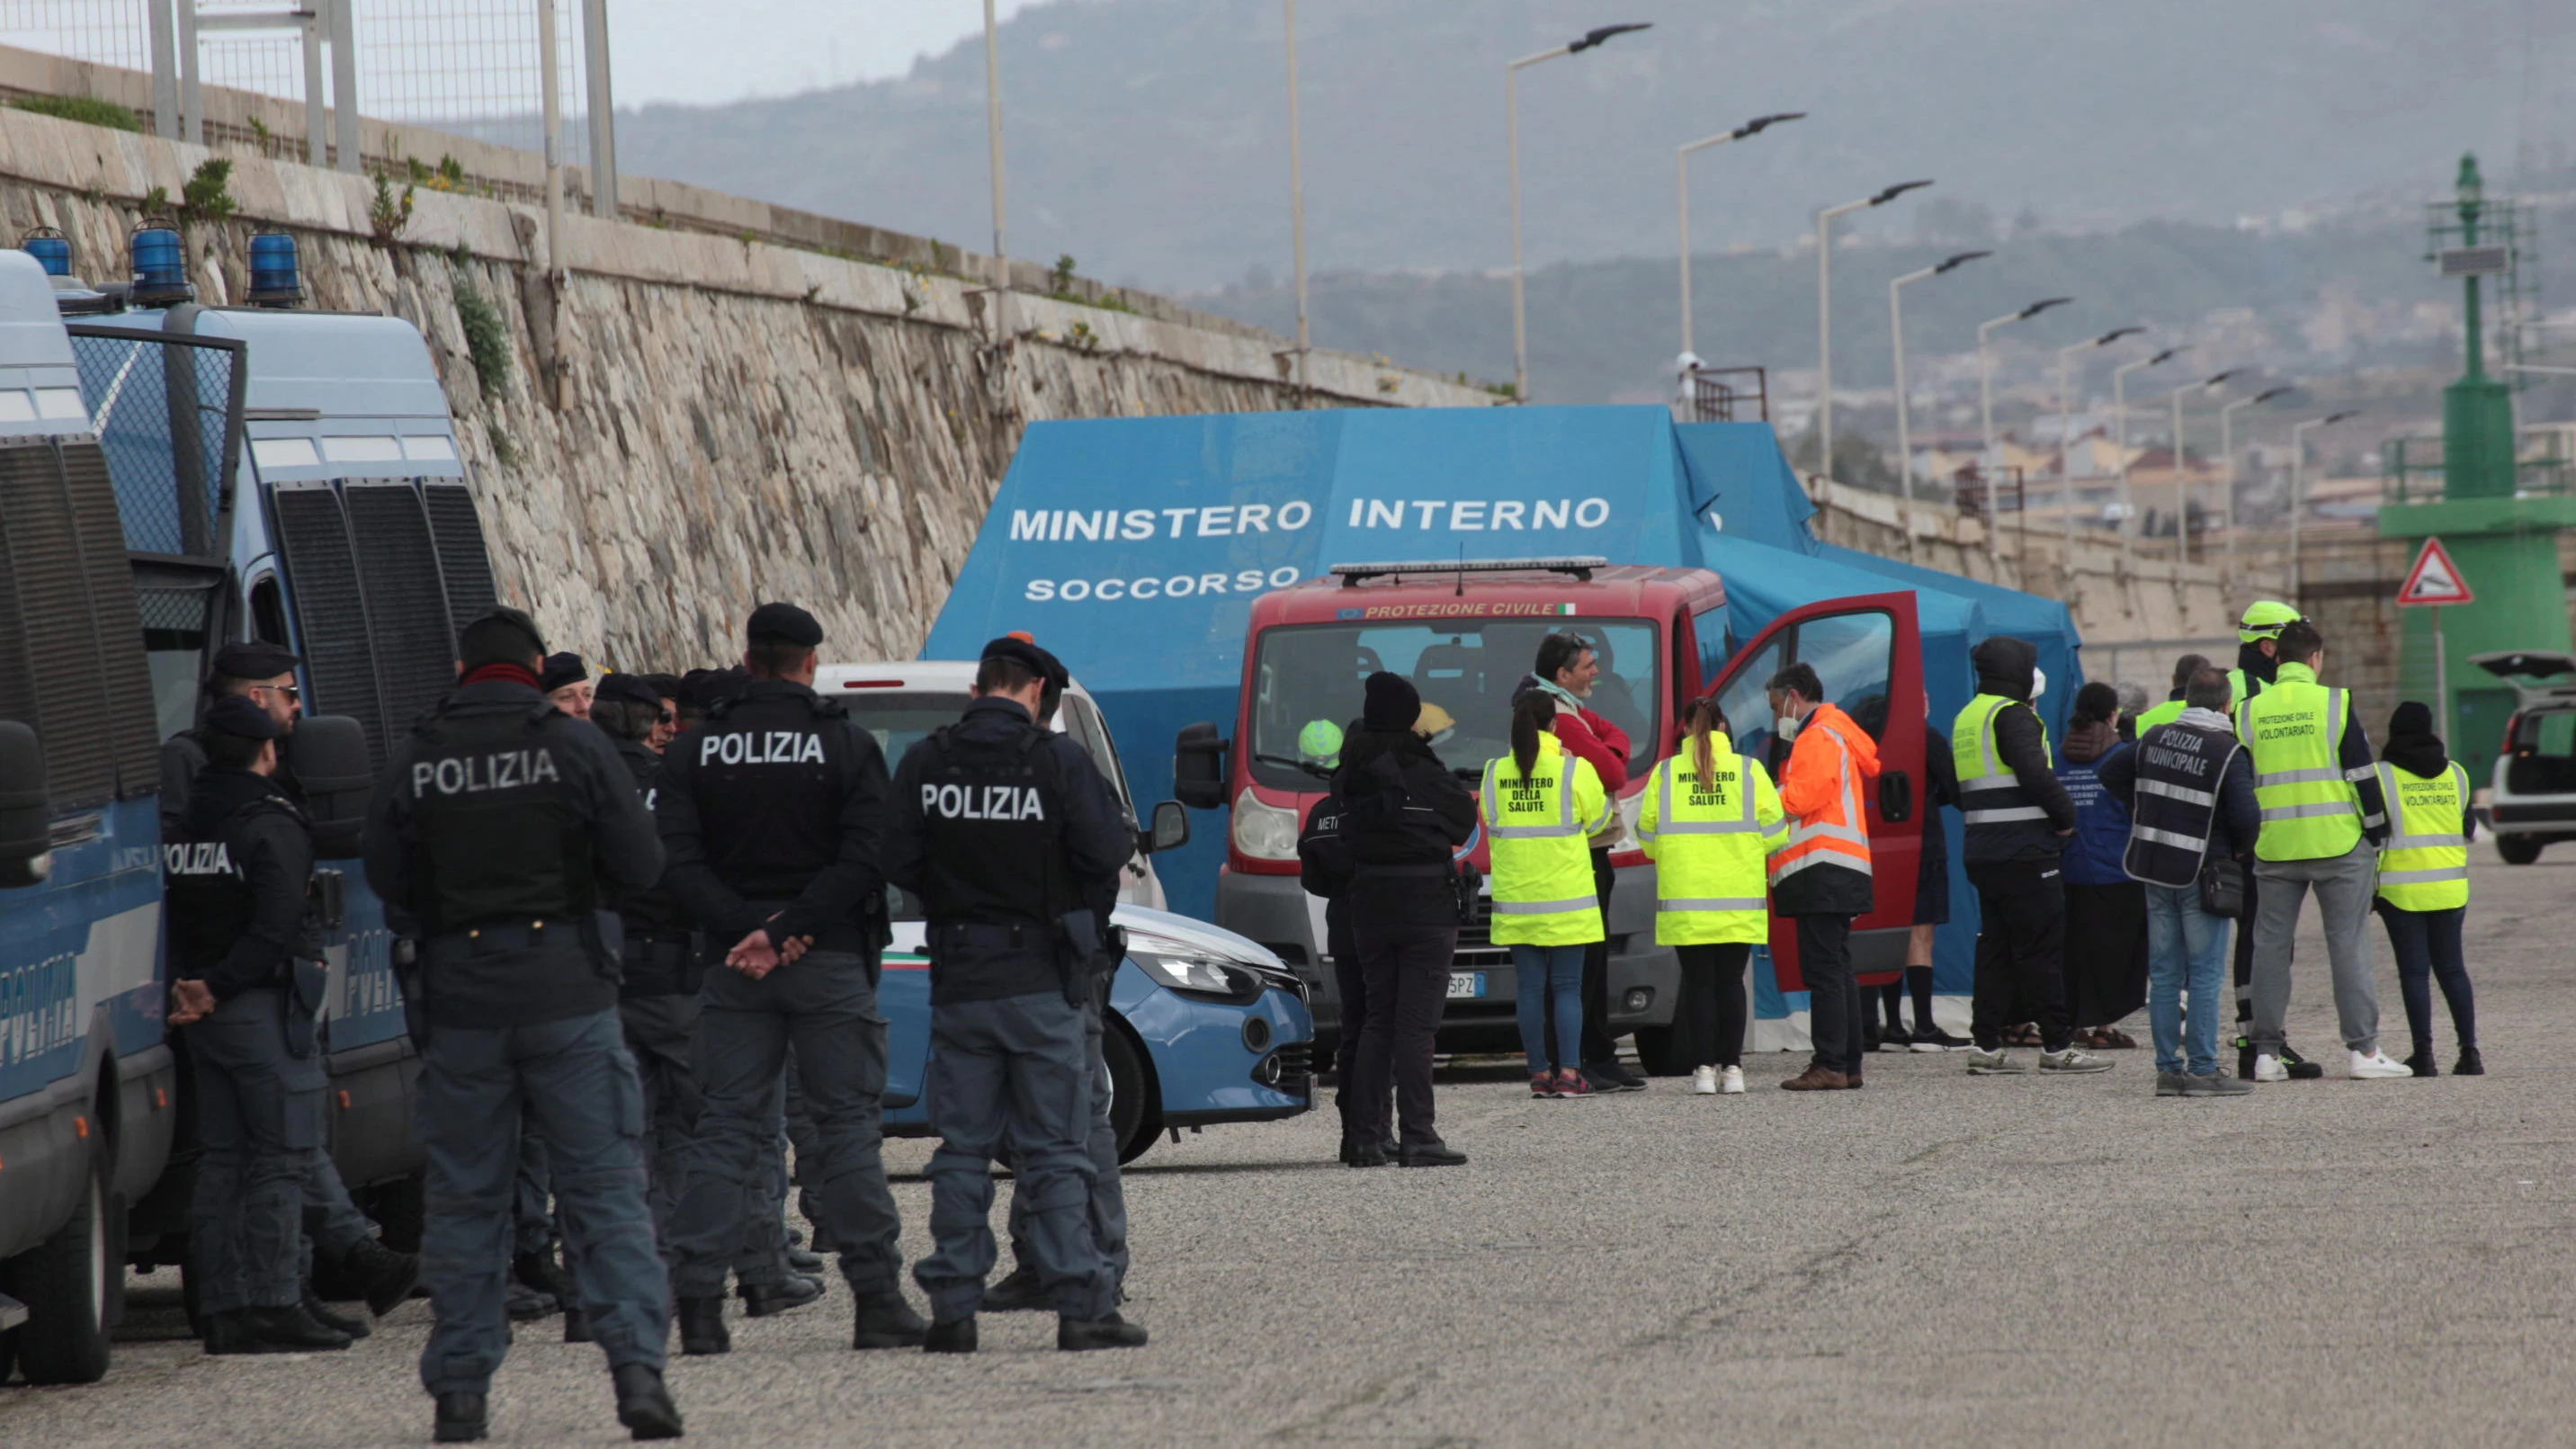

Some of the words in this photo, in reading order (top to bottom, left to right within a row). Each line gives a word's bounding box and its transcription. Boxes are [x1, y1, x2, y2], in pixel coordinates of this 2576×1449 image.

[1009, 500, 1312, 541] MINISTERO
[1349, 497, 1610, 531] INTERNO
[1024, 566, 1300, 601] SOCCORSO
[1365, 603, 1486, 618] PROTEZIONE
[1491, 603, 1554, 615] CIVILE
[2258, 713, 2294, 725] PROTEZIONE
[2258, 724, 2315, 740] VOLONTARIATO
[700, 731, 825, 766] POLIZIA
[2160, 729, 2204, 753] POLIZIA
[2145, 746, 2208, 776] MUNICIPALE
[413, 747, 560, 799] POLIZIA
[1678, 771, 1735, 783] MINERO
[1499, 777, 1553, 789] MINITERO
[921, 783, 1044, 821] POLIZIA
[1507, 801, 1544, 812] SALUTE
[1689, 794, 1726, 806] SALUTE
[2405, 794, 2457, 807] VOLONTARIATO
